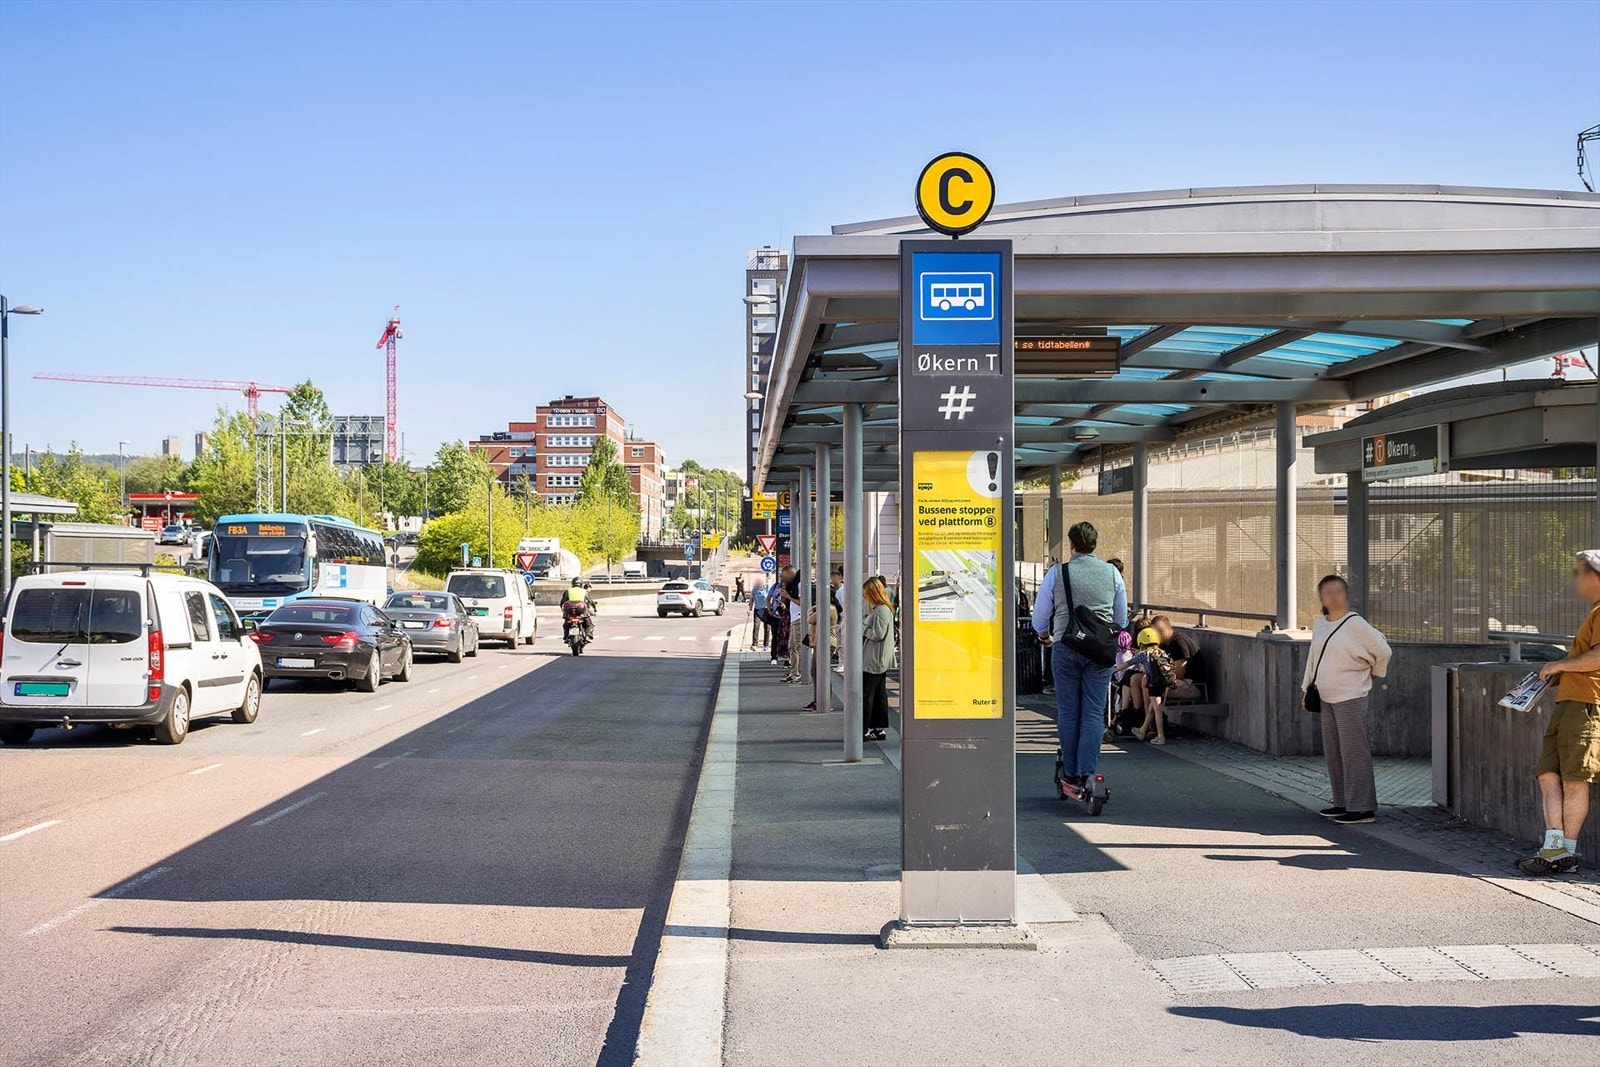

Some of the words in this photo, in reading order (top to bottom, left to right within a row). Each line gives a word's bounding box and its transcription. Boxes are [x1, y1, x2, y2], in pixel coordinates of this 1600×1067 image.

[939, 167, 974, 215] C
[918, 353, 978, 372] Økern
[985, 354, 998, 371] T
[1387, 440, 1409, 458] Økern
[918, 505, 958, 515] Bussene
[959, 506, 996, 516] stopper
[918, 517, 936, 526] ved
[938, 517, 983, 527] plattform
[228, 525, 248, 535] FB3A
